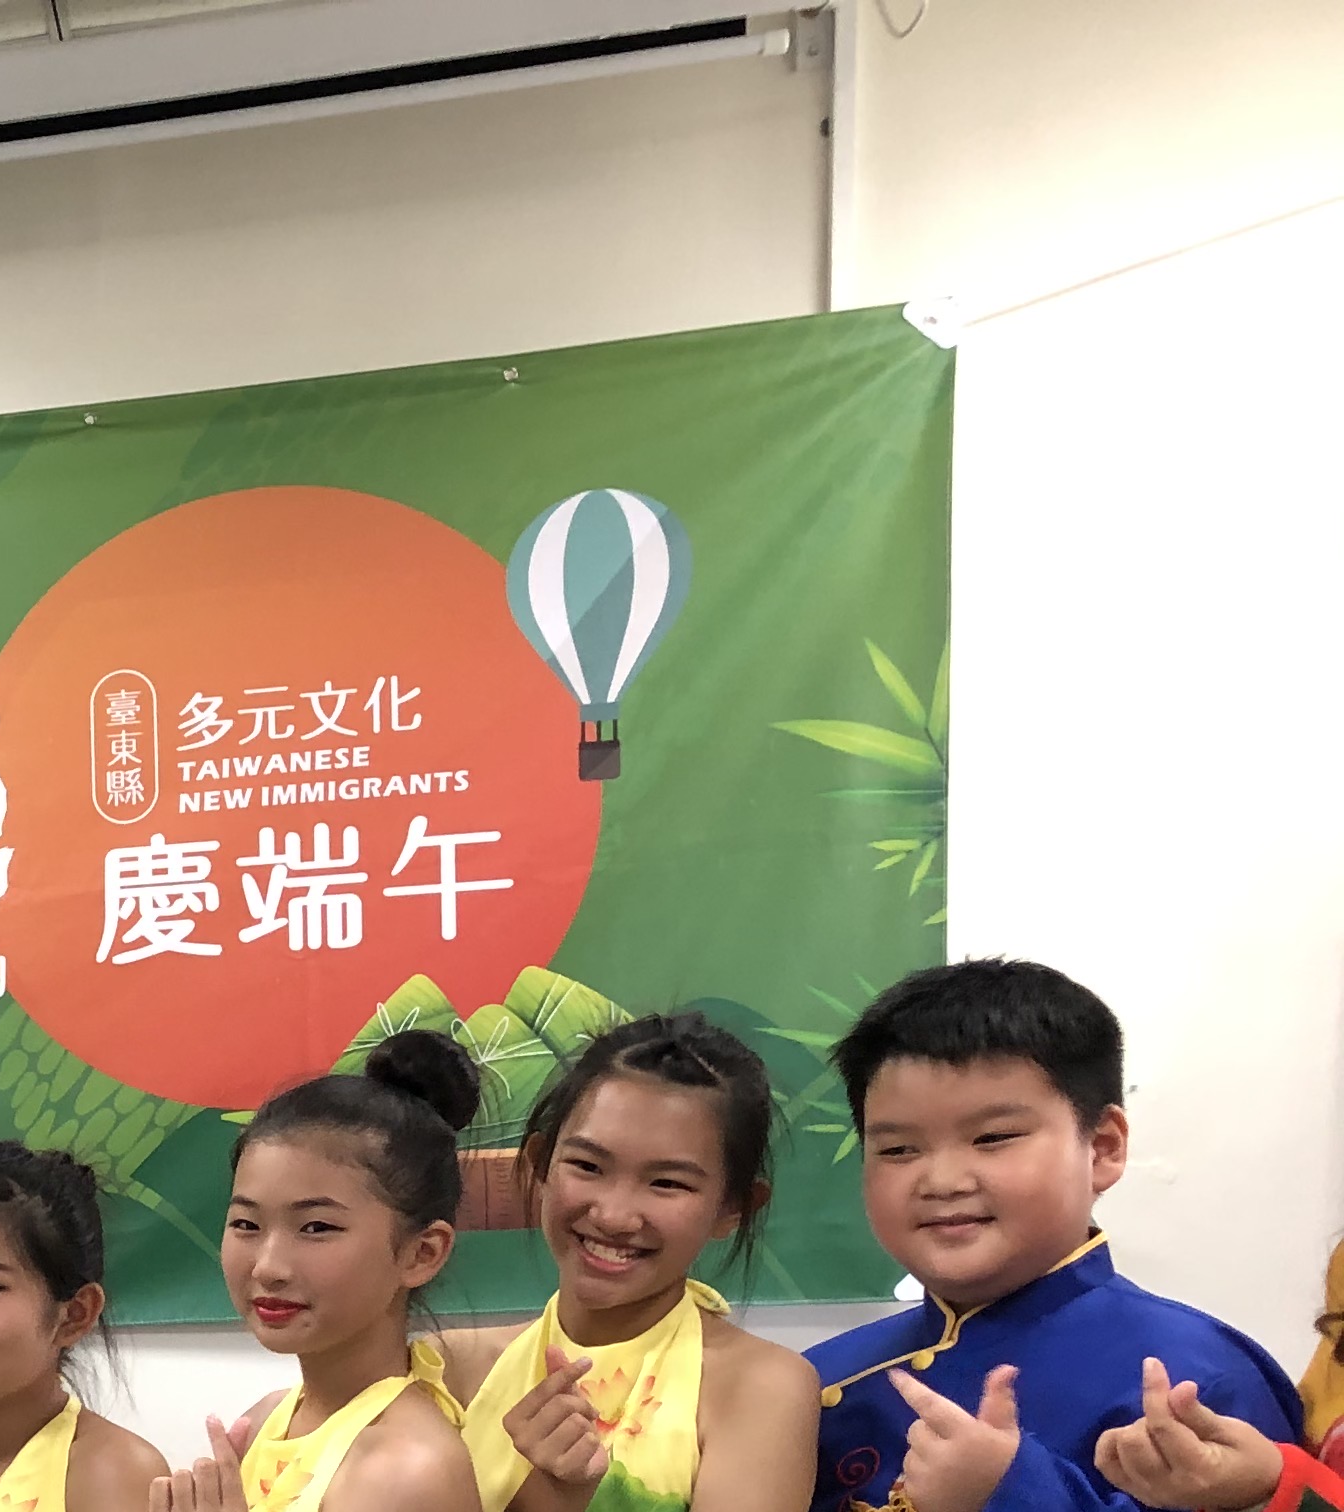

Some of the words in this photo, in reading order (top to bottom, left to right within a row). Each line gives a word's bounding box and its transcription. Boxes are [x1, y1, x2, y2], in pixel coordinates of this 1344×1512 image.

[105, 689, 145, 807] 臺東縣
[178, 676, 422, 752] 多元文化
[178, 746, 370, 782] TAIWANESE
[179, 788, 252, 814] NEW
[261, 770, 469, 807] IMMIGRANTS
[95, 815, 514, 965] 慶端午
